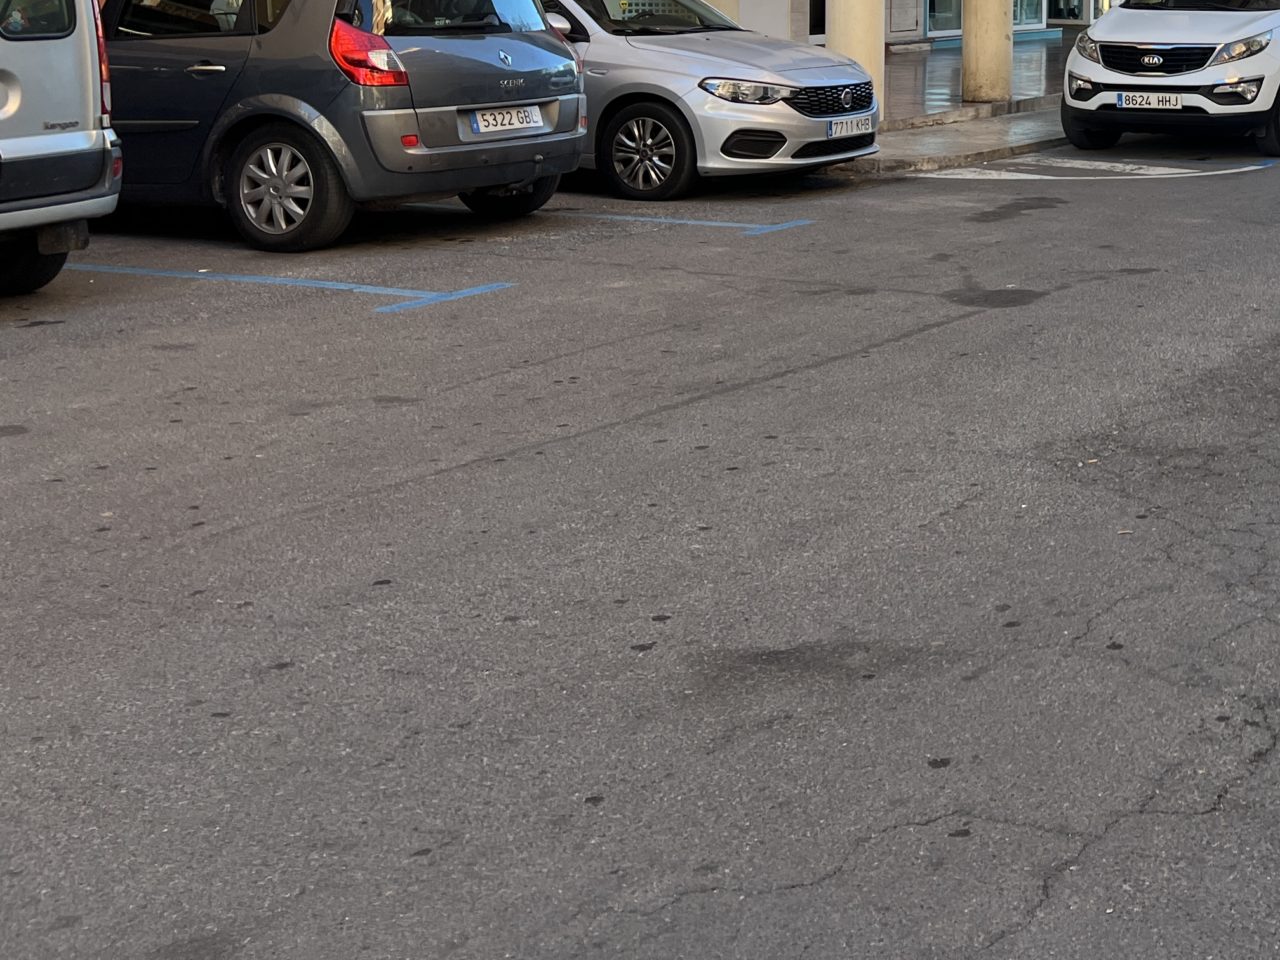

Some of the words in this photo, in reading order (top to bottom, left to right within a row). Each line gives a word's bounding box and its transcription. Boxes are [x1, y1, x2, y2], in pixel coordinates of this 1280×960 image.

[1143, 56, 1160, 65] KIA
[499, 78, 526, 88] SCENIC
[1124, 95, 1152, 107] 8624
[1157, 95, 1179, 107] HHJ
[480, 111, 515, 128] 5322
[516, 110, 539, 125] GBL
[833, 120, 854, 135] 7711
[855, 118, 871, 132] KHB
